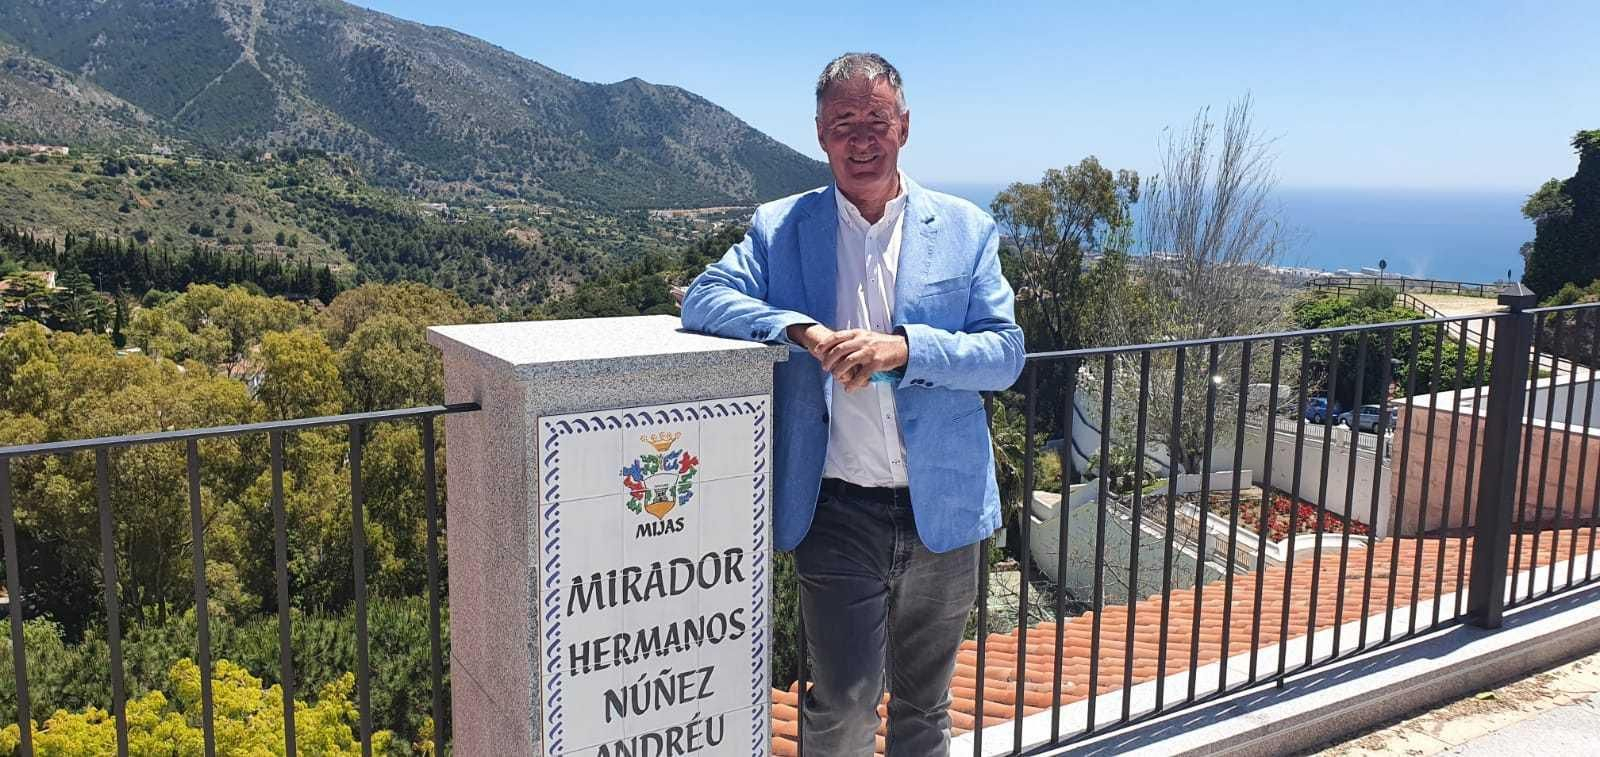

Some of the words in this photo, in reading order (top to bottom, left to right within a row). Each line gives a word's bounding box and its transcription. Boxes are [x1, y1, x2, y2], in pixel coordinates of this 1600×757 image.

[636, 517, 685, 539] MIJAS
[567, 547, 745, 616] MIRADOR
[568, 607, 746, 676] HERMANOS
[604, 666, 715, 723] NÚÑEZ
